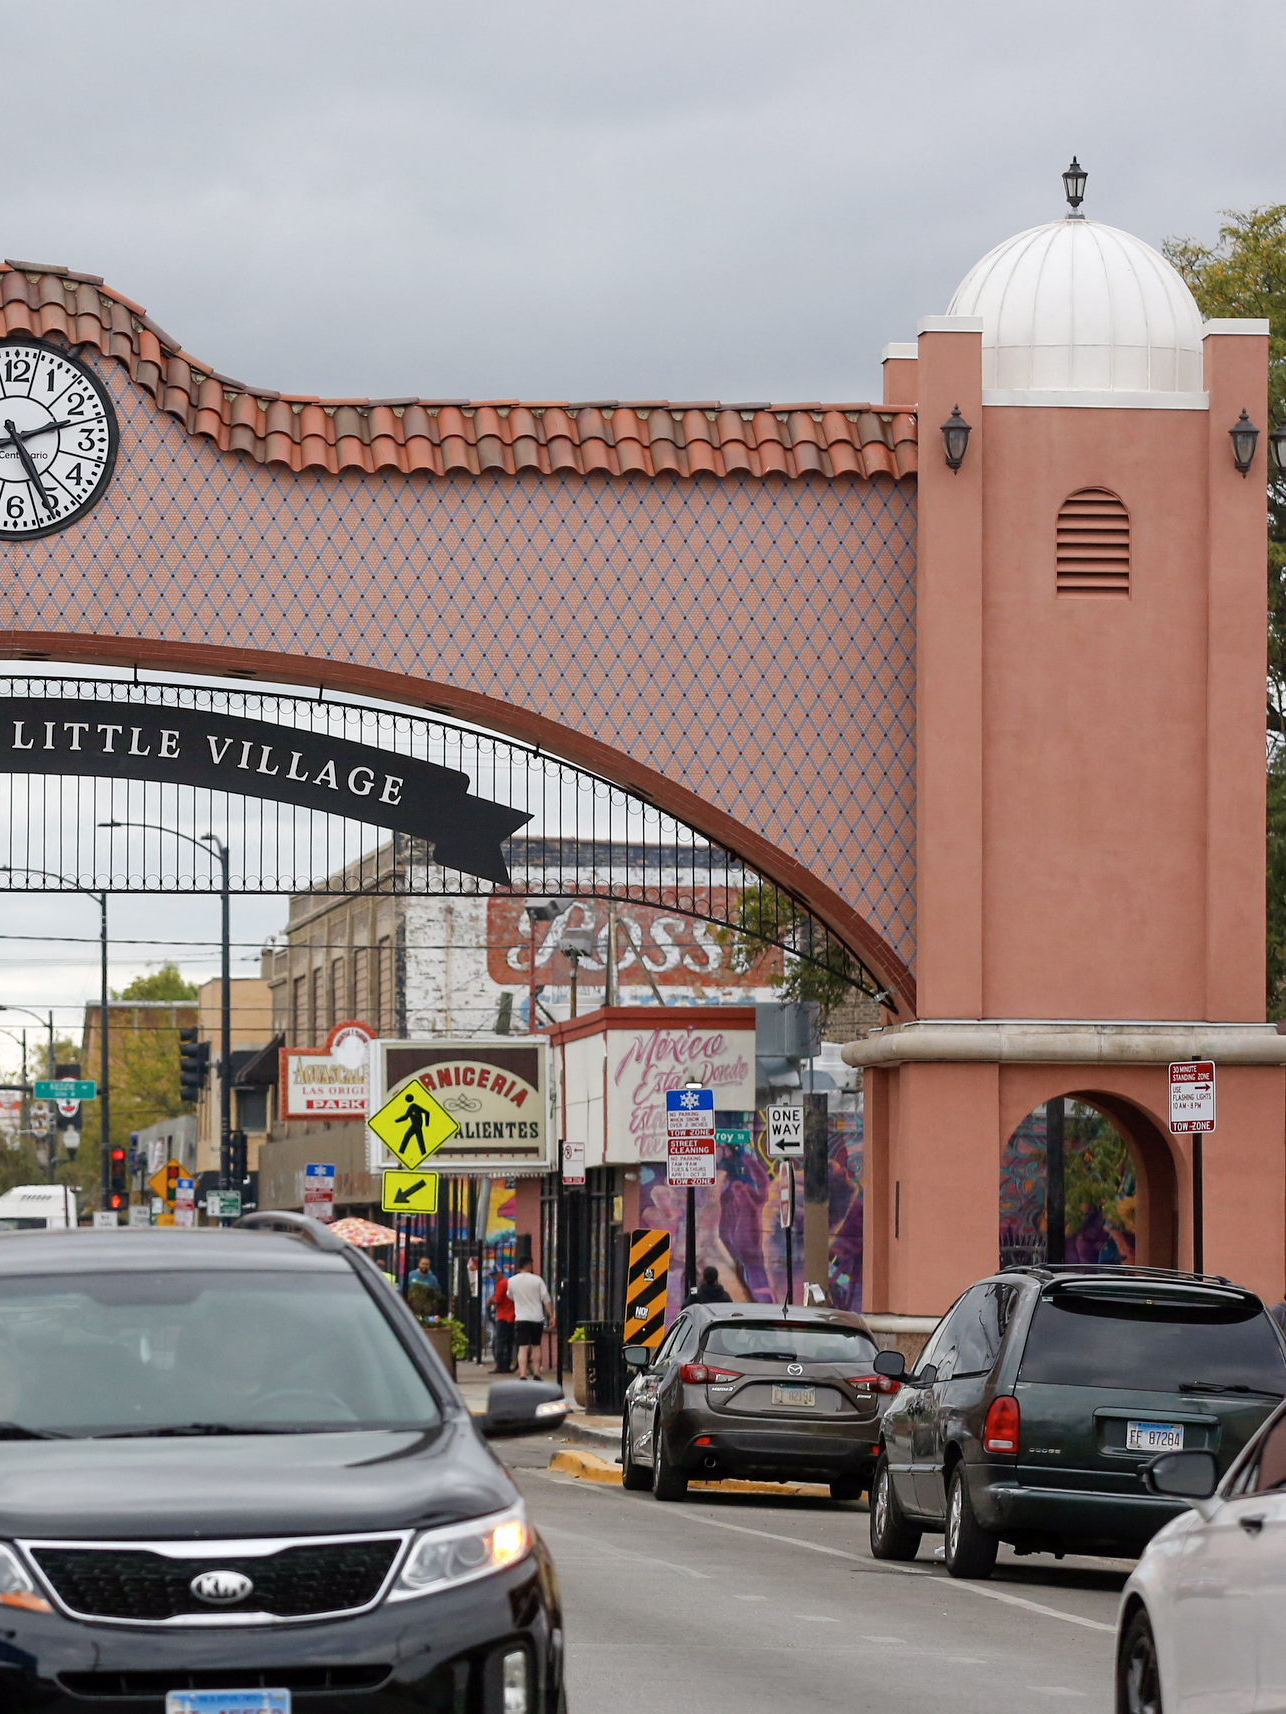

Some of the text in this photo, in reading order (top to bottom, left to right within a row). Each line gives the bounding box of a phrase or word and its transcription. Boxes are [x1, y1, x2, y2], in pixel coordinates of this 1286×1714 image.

[4, 359, 31, 383] 12
[46, 368, 55, 392] 1
[67, 392, 85, 416] 2
[77, 428, 96, 452] 3
[65, 462, 83, 486] 4
[41, 486, 59, 510] 5
[6, 495, 25, 519] 6
[11, 721, 181, 759] LITTLE
[205, 735, 405, 805] VILLAGE
[1172, 1072, 1210, 1082] STANDING ZONE
[302, 1087, 325, 1095] LAS
[399, 1067, 529, 1108] RNICERIA
[1172, 1086, 1181, 1094] USE
[1172, 1092, 1212, 1102] FLASHING LIGHTS
[772, 1110, 801, 1121] ONE
[772, 1123, 801, 1136] WAY
[670, 1140, 698, 1148] STREET
[715, 1132, 734, 1143] roy
[670, 1146, 710, 1154] CLEANING
[635, 1306, 649, 1317] NO!
[1130, 1429, 1180, 1447] FF 87284
